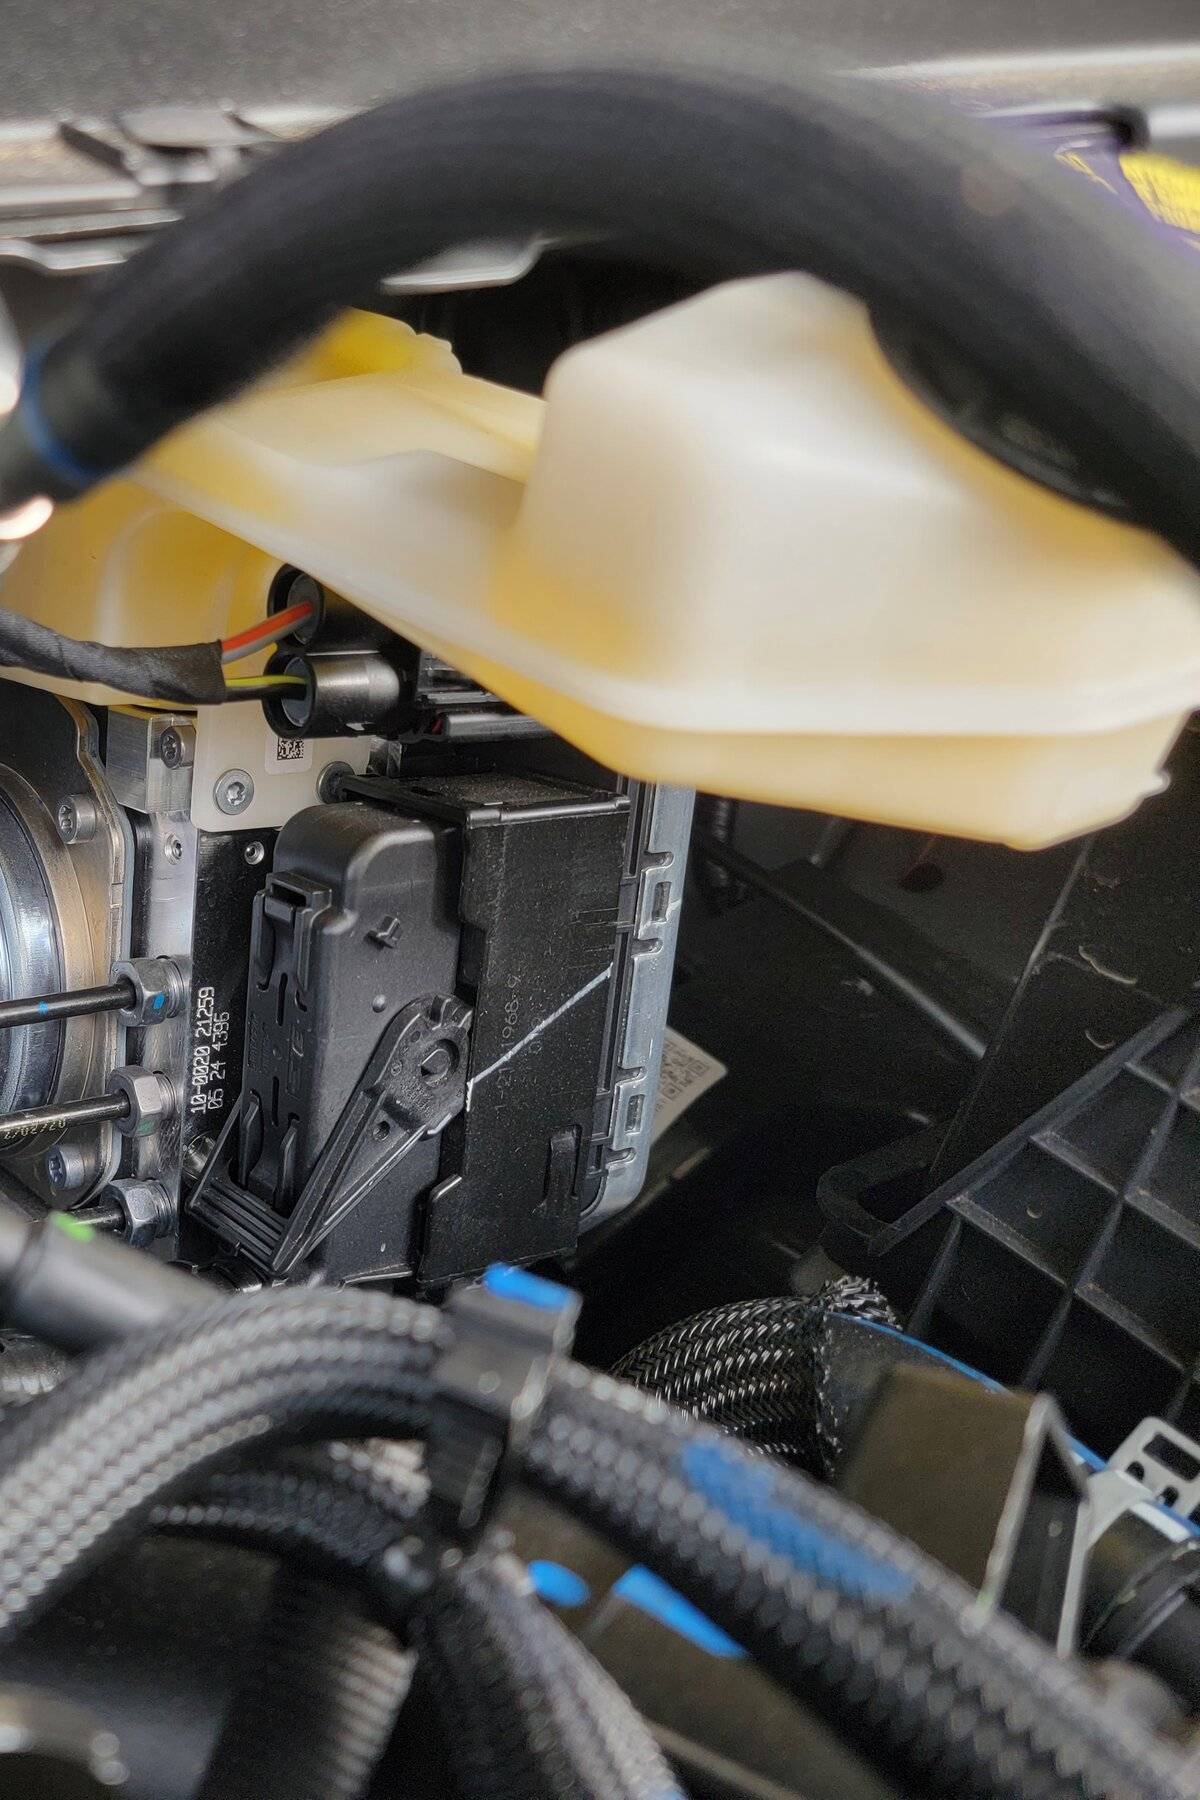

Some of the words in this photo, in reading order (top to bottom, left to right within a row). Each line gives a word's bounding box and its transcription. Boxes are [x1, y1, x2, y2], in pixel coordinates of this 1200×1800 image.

[195, 986, 215, 1038] 21259
[212, 1011, 229, 1052] 4396
[190, 1045, 211, 1115] 10-0020
[210, 1061, 226, 1080] 24
[207, 1088, 224, 1110] 05
